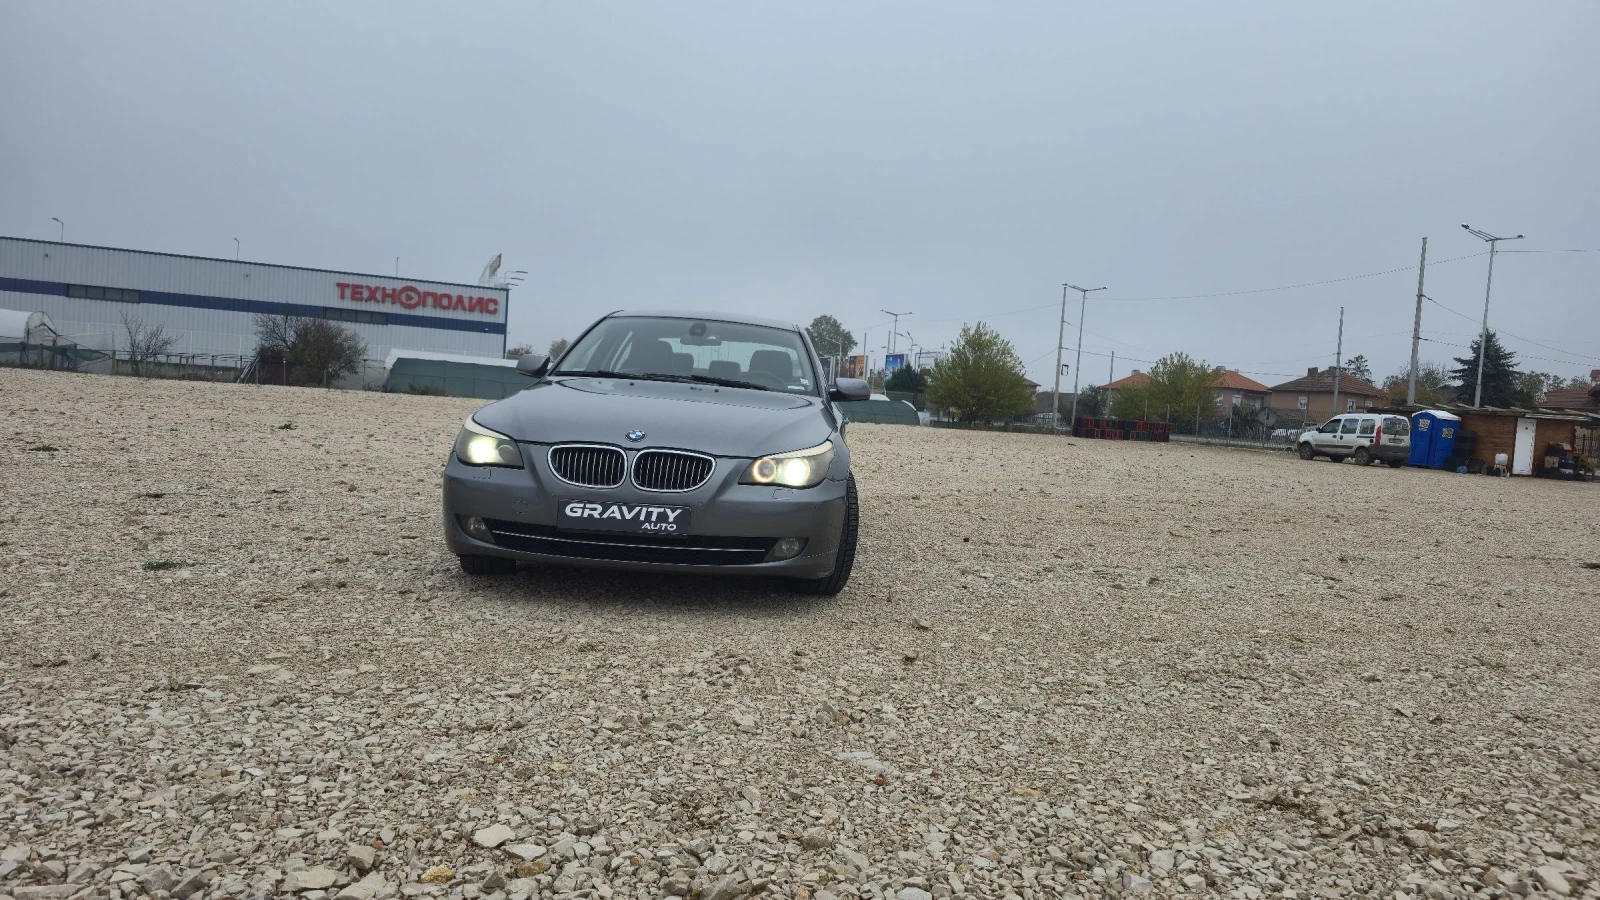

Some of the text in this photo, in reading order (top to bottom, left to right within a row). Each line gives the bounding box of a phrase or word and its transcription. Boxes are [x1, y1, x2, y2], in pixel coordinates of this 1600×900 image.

[336, 282, 499, 315] ТЕХНОПОЛИС
[565, 503, 683, 522] GRAVITY
[641, 522, 677, 531] AUTO
